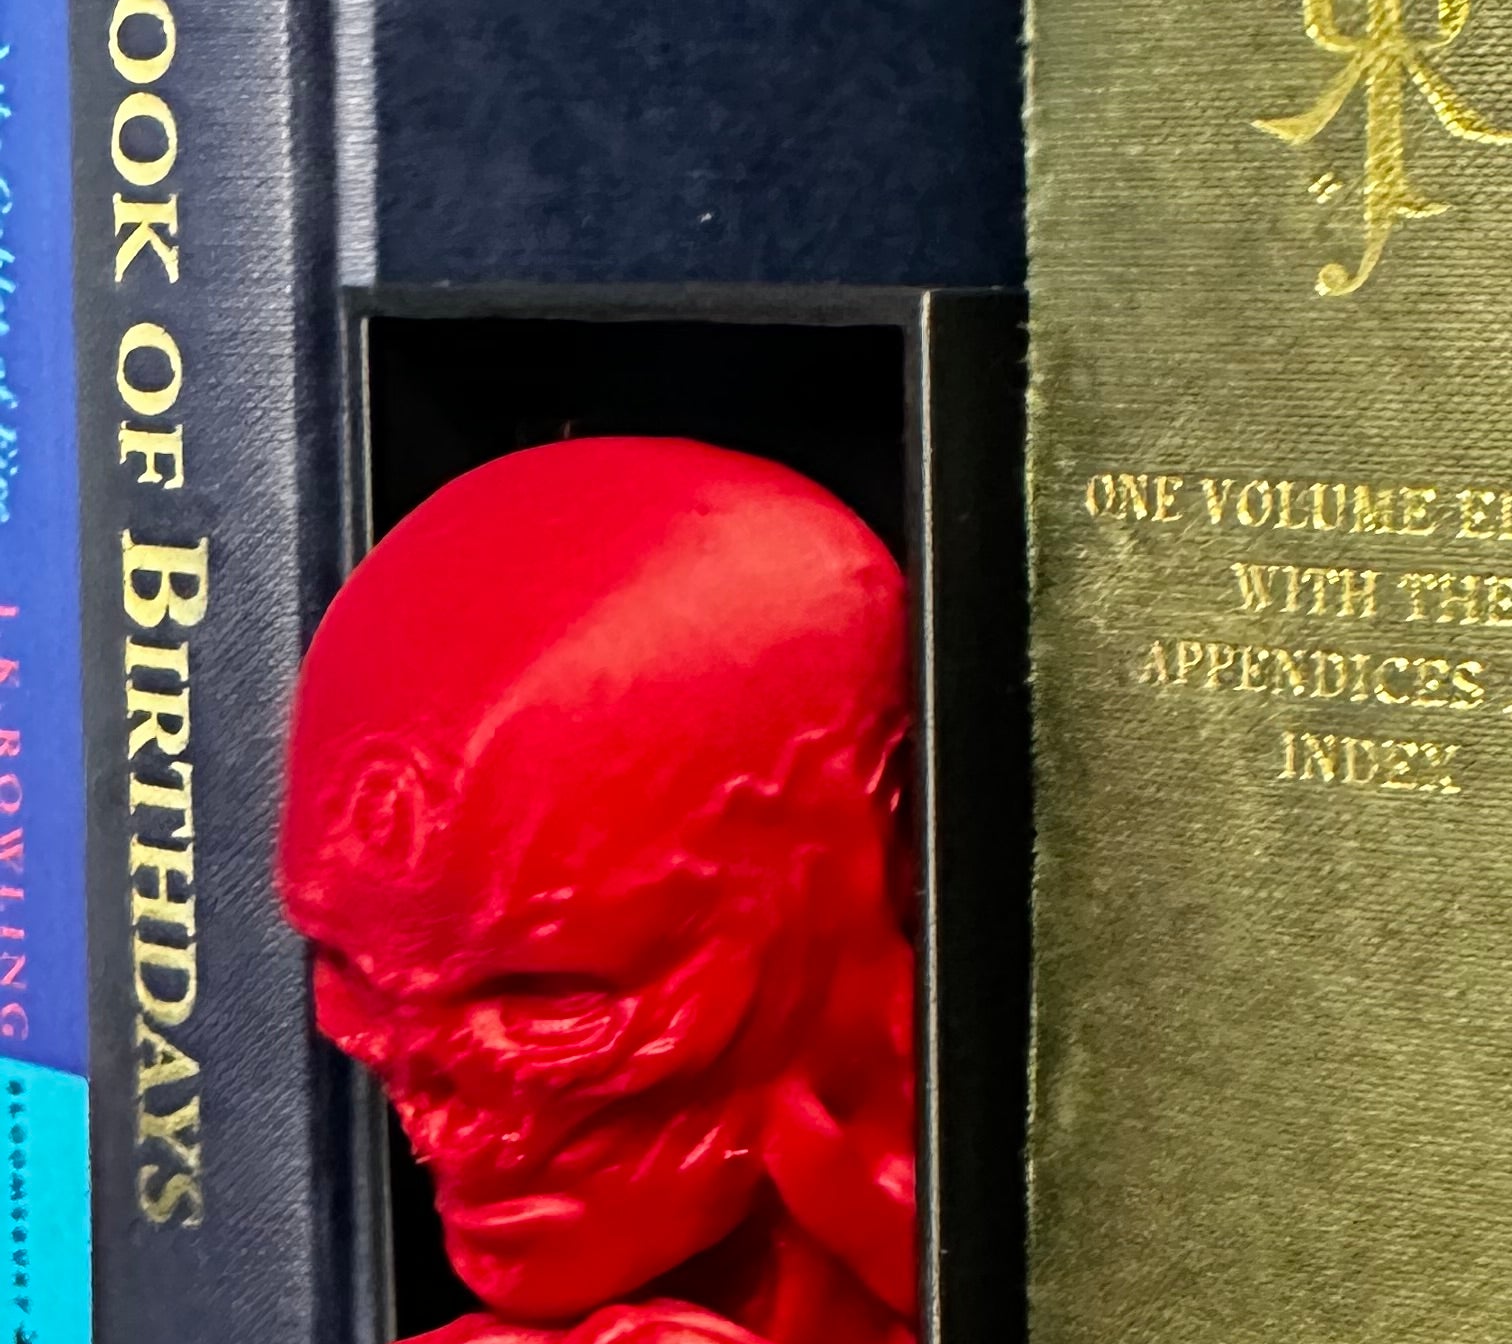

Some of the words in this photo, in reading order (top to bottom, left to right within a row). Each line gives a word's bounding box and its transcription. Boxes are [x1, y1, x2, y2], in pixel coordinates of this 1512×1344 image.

[115, 321, 186, 491] OF
[1084, 471, 1184, 523] ONE
[1199, 477, 1441, 538] VOLUME
[1229, 561, 1383, 618] WITH
[1137, 639, 1486, 711] APPENDICES
[1275, 730, 1462, 795] INDEX
[120, 527, 210, 1228] BIRTHDAYS
